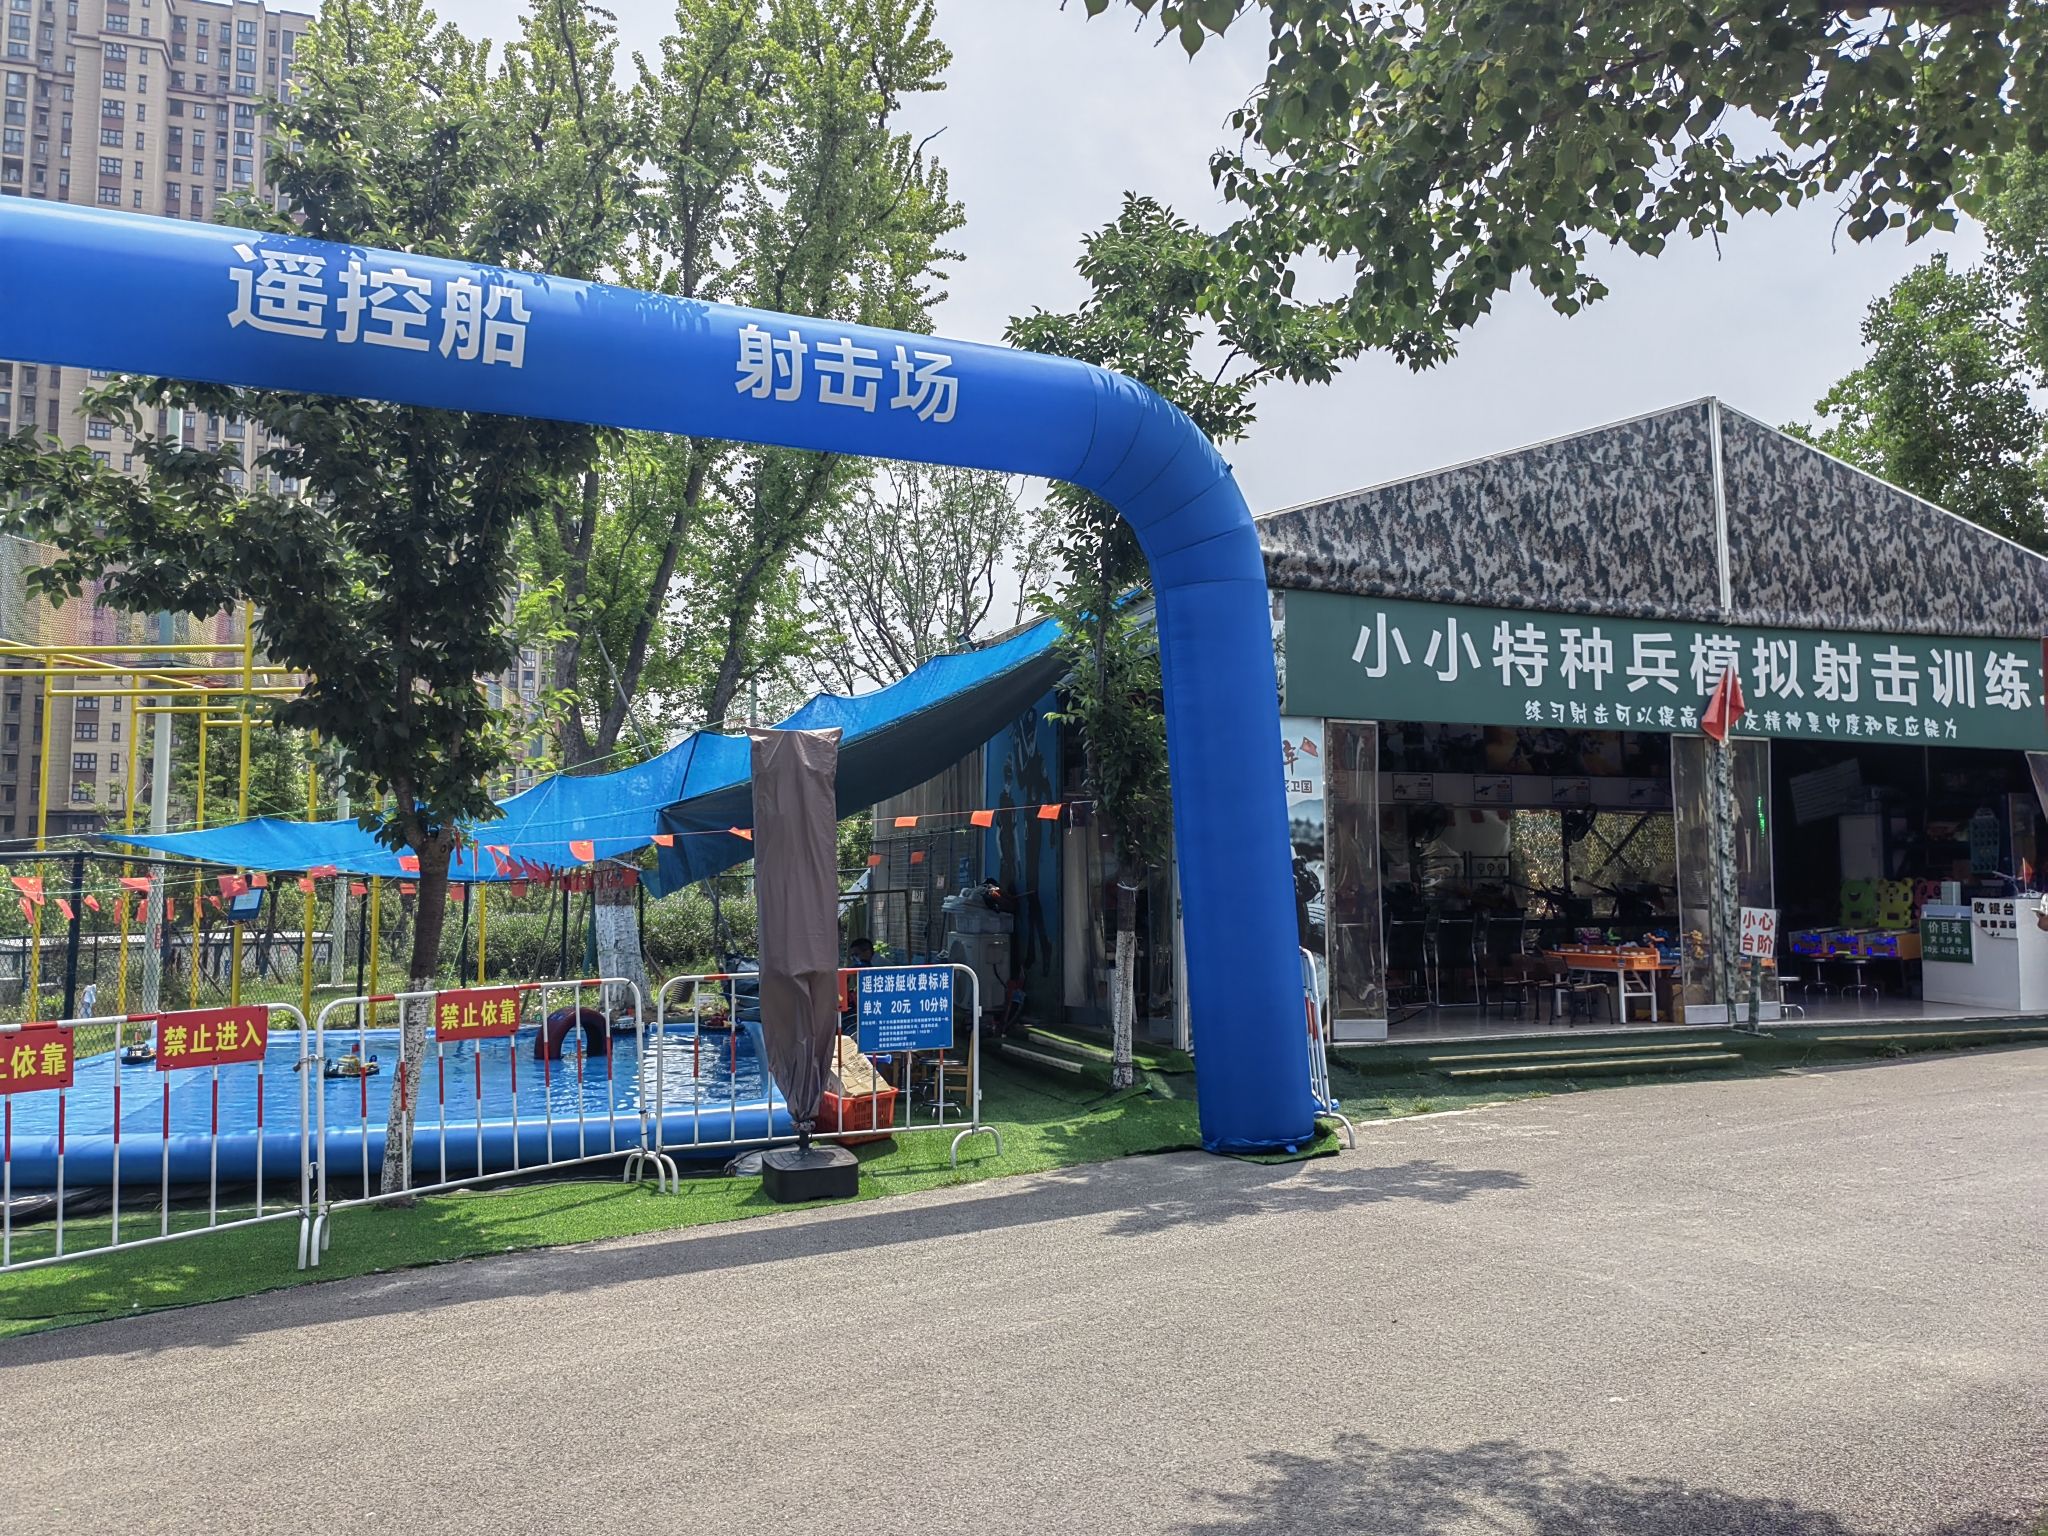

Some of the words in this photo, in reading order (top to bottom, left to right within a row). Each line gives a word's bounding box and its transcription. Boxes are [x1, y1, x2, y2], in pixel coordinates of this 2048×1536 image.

[227, 244, 532, 368] 遥控船
[735, 324, 958, 422] 射击场
[1352, 612, 2045, 710] 小小特种兵模拟射击训练
[1524, 700, 1957, 739] 练习射击可以提高友精神集中度和反应能力
[1974, 901, 2014, 916] 收银台
[1742, 910, 1774, 932] 小心
[1928, 921, 1963, 935] 价目表
[1742, 932, 1773, 954] 台阶
[862, 972, 949, 993] 遥控游艇收费标准
[440, 998, 517, 1031] 禁止依靠
[863, 1000, 882, 1016] 单次
[891, 999, 911, 1014] 20元
[920, 997, 948, 1013] 10分钟
[163, 1020, 262, 1057] 禁止进入
